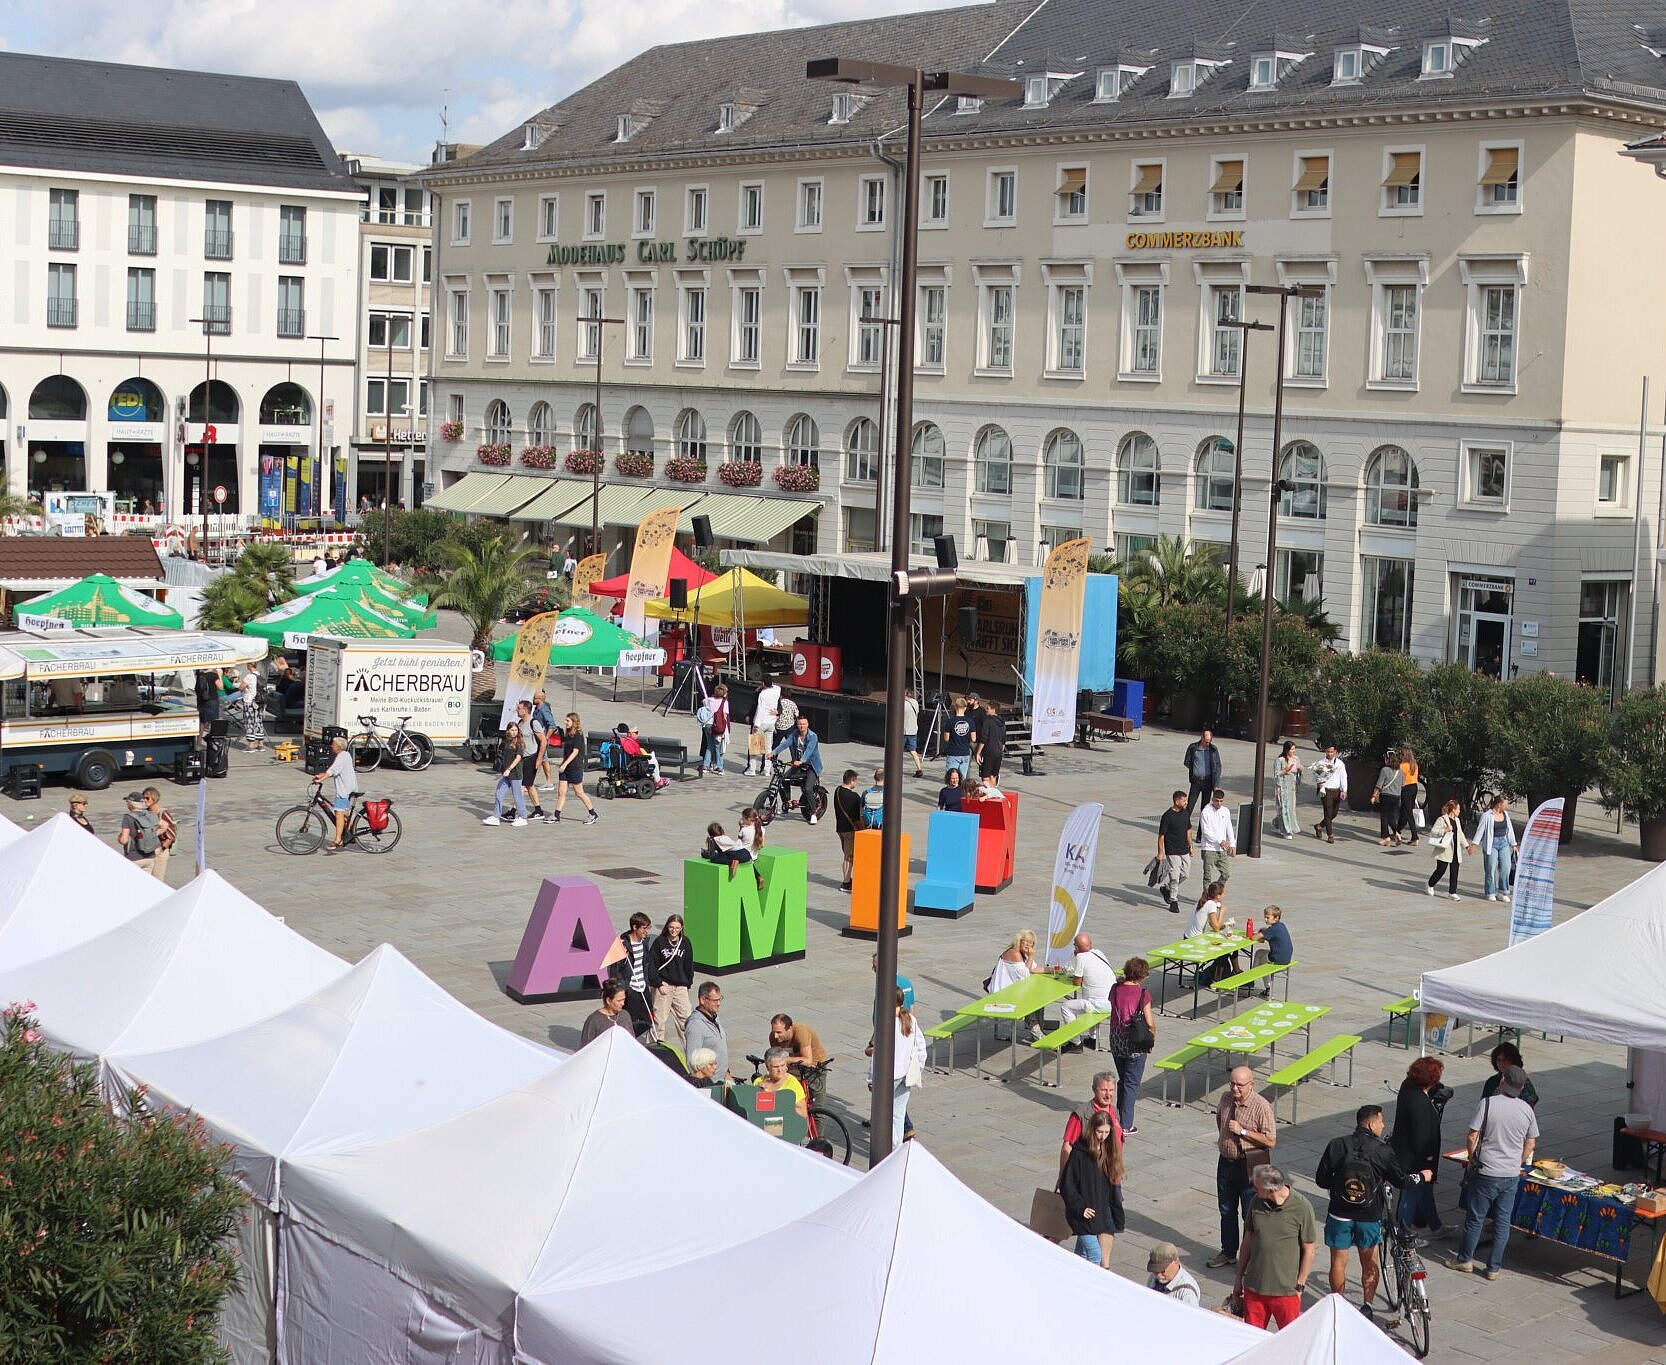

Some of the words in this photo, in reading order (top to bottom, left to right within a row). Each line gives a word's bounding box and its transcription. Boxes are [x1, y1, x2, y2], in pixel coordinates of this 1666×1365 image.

[1126, 230, 1245, 249] COMMERZBANK
[546, 243, 626, 265] MODEHAUS
[636, 238, 677, 263] CARL
[687, 237, 747, 261] SCHÖPF
[1468, 582, 1504, 590] COMMERZBANK
[372, 656, 397, 669] Jetzt
[398, 656, 419, 667] kühl
